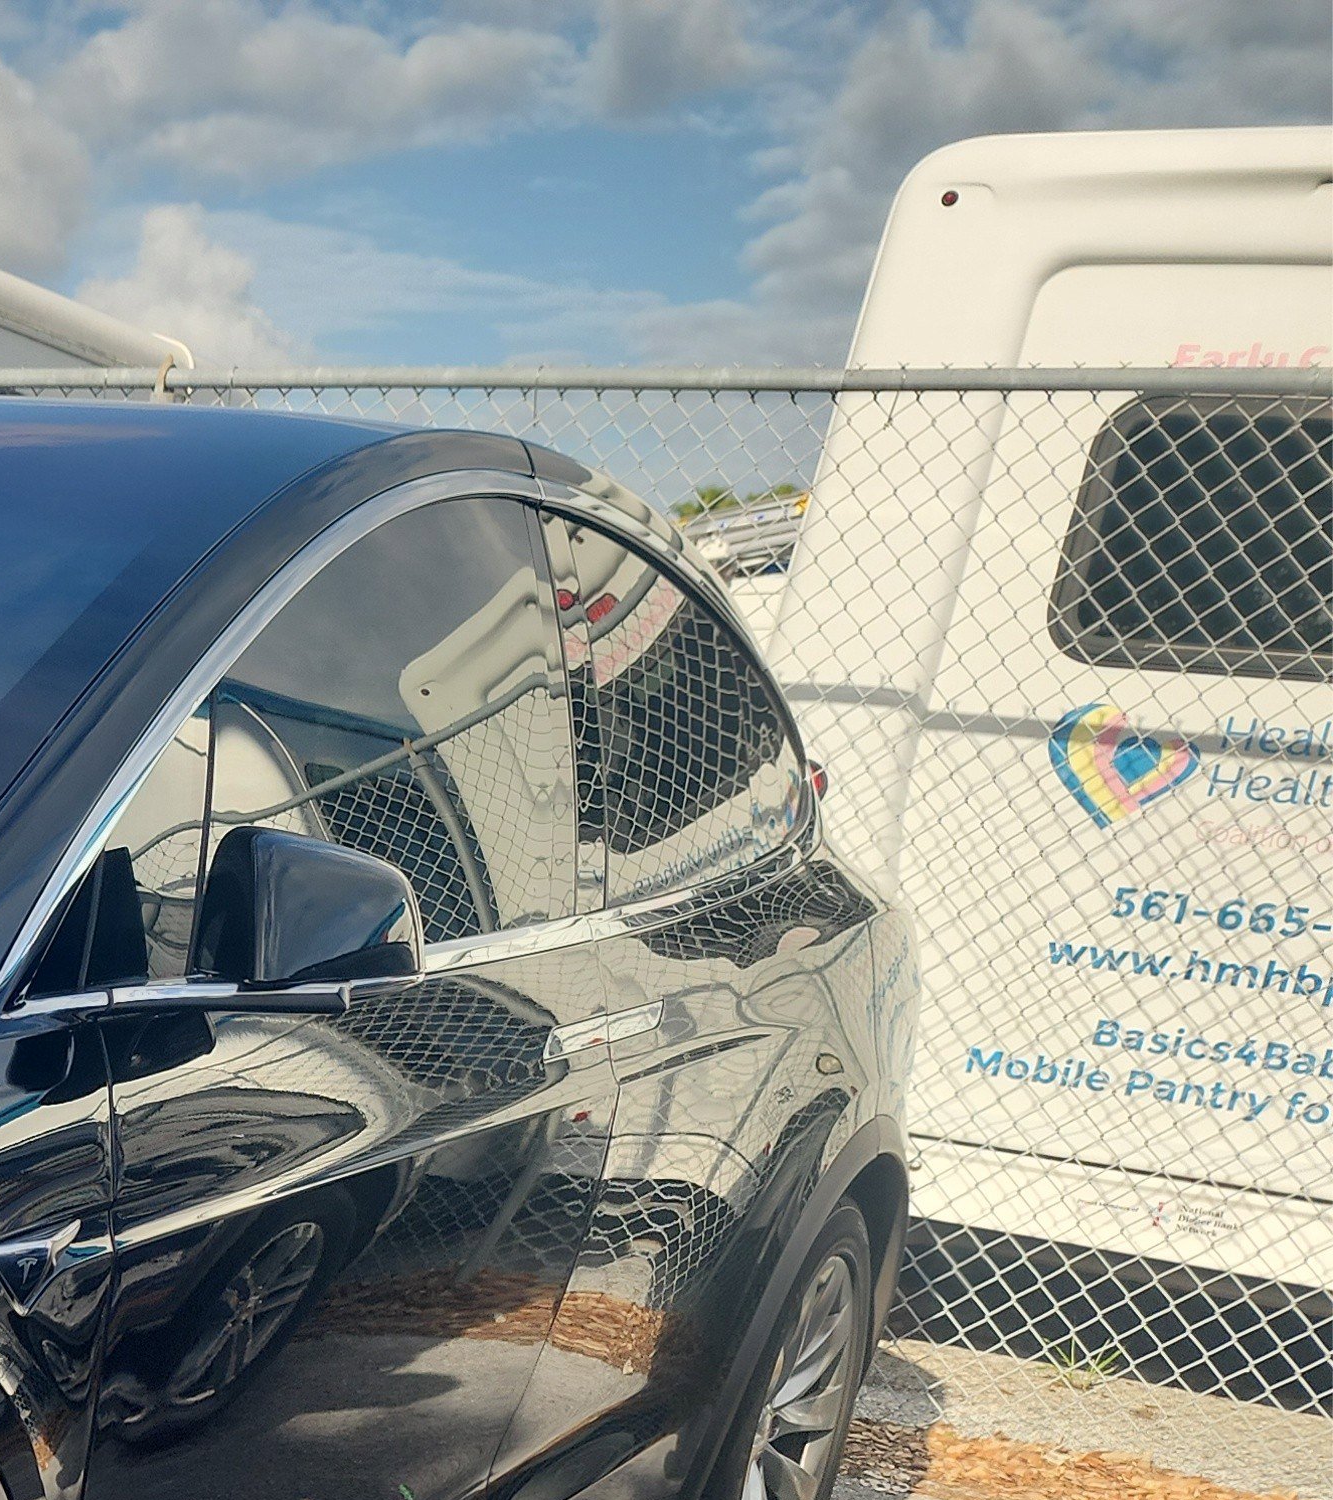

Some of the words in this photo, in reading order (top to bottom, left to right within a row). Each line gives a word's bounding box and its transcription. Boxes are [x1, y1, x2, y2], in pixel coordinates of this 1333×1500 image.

[1110, 886, 1332, 938] 561-665-
[1091, 1019, 1333, 1080] Basics4Bab
[965, 1046, 1110, 1092] Mobile
[1124, 1069, 1272, 1122] Pantry
